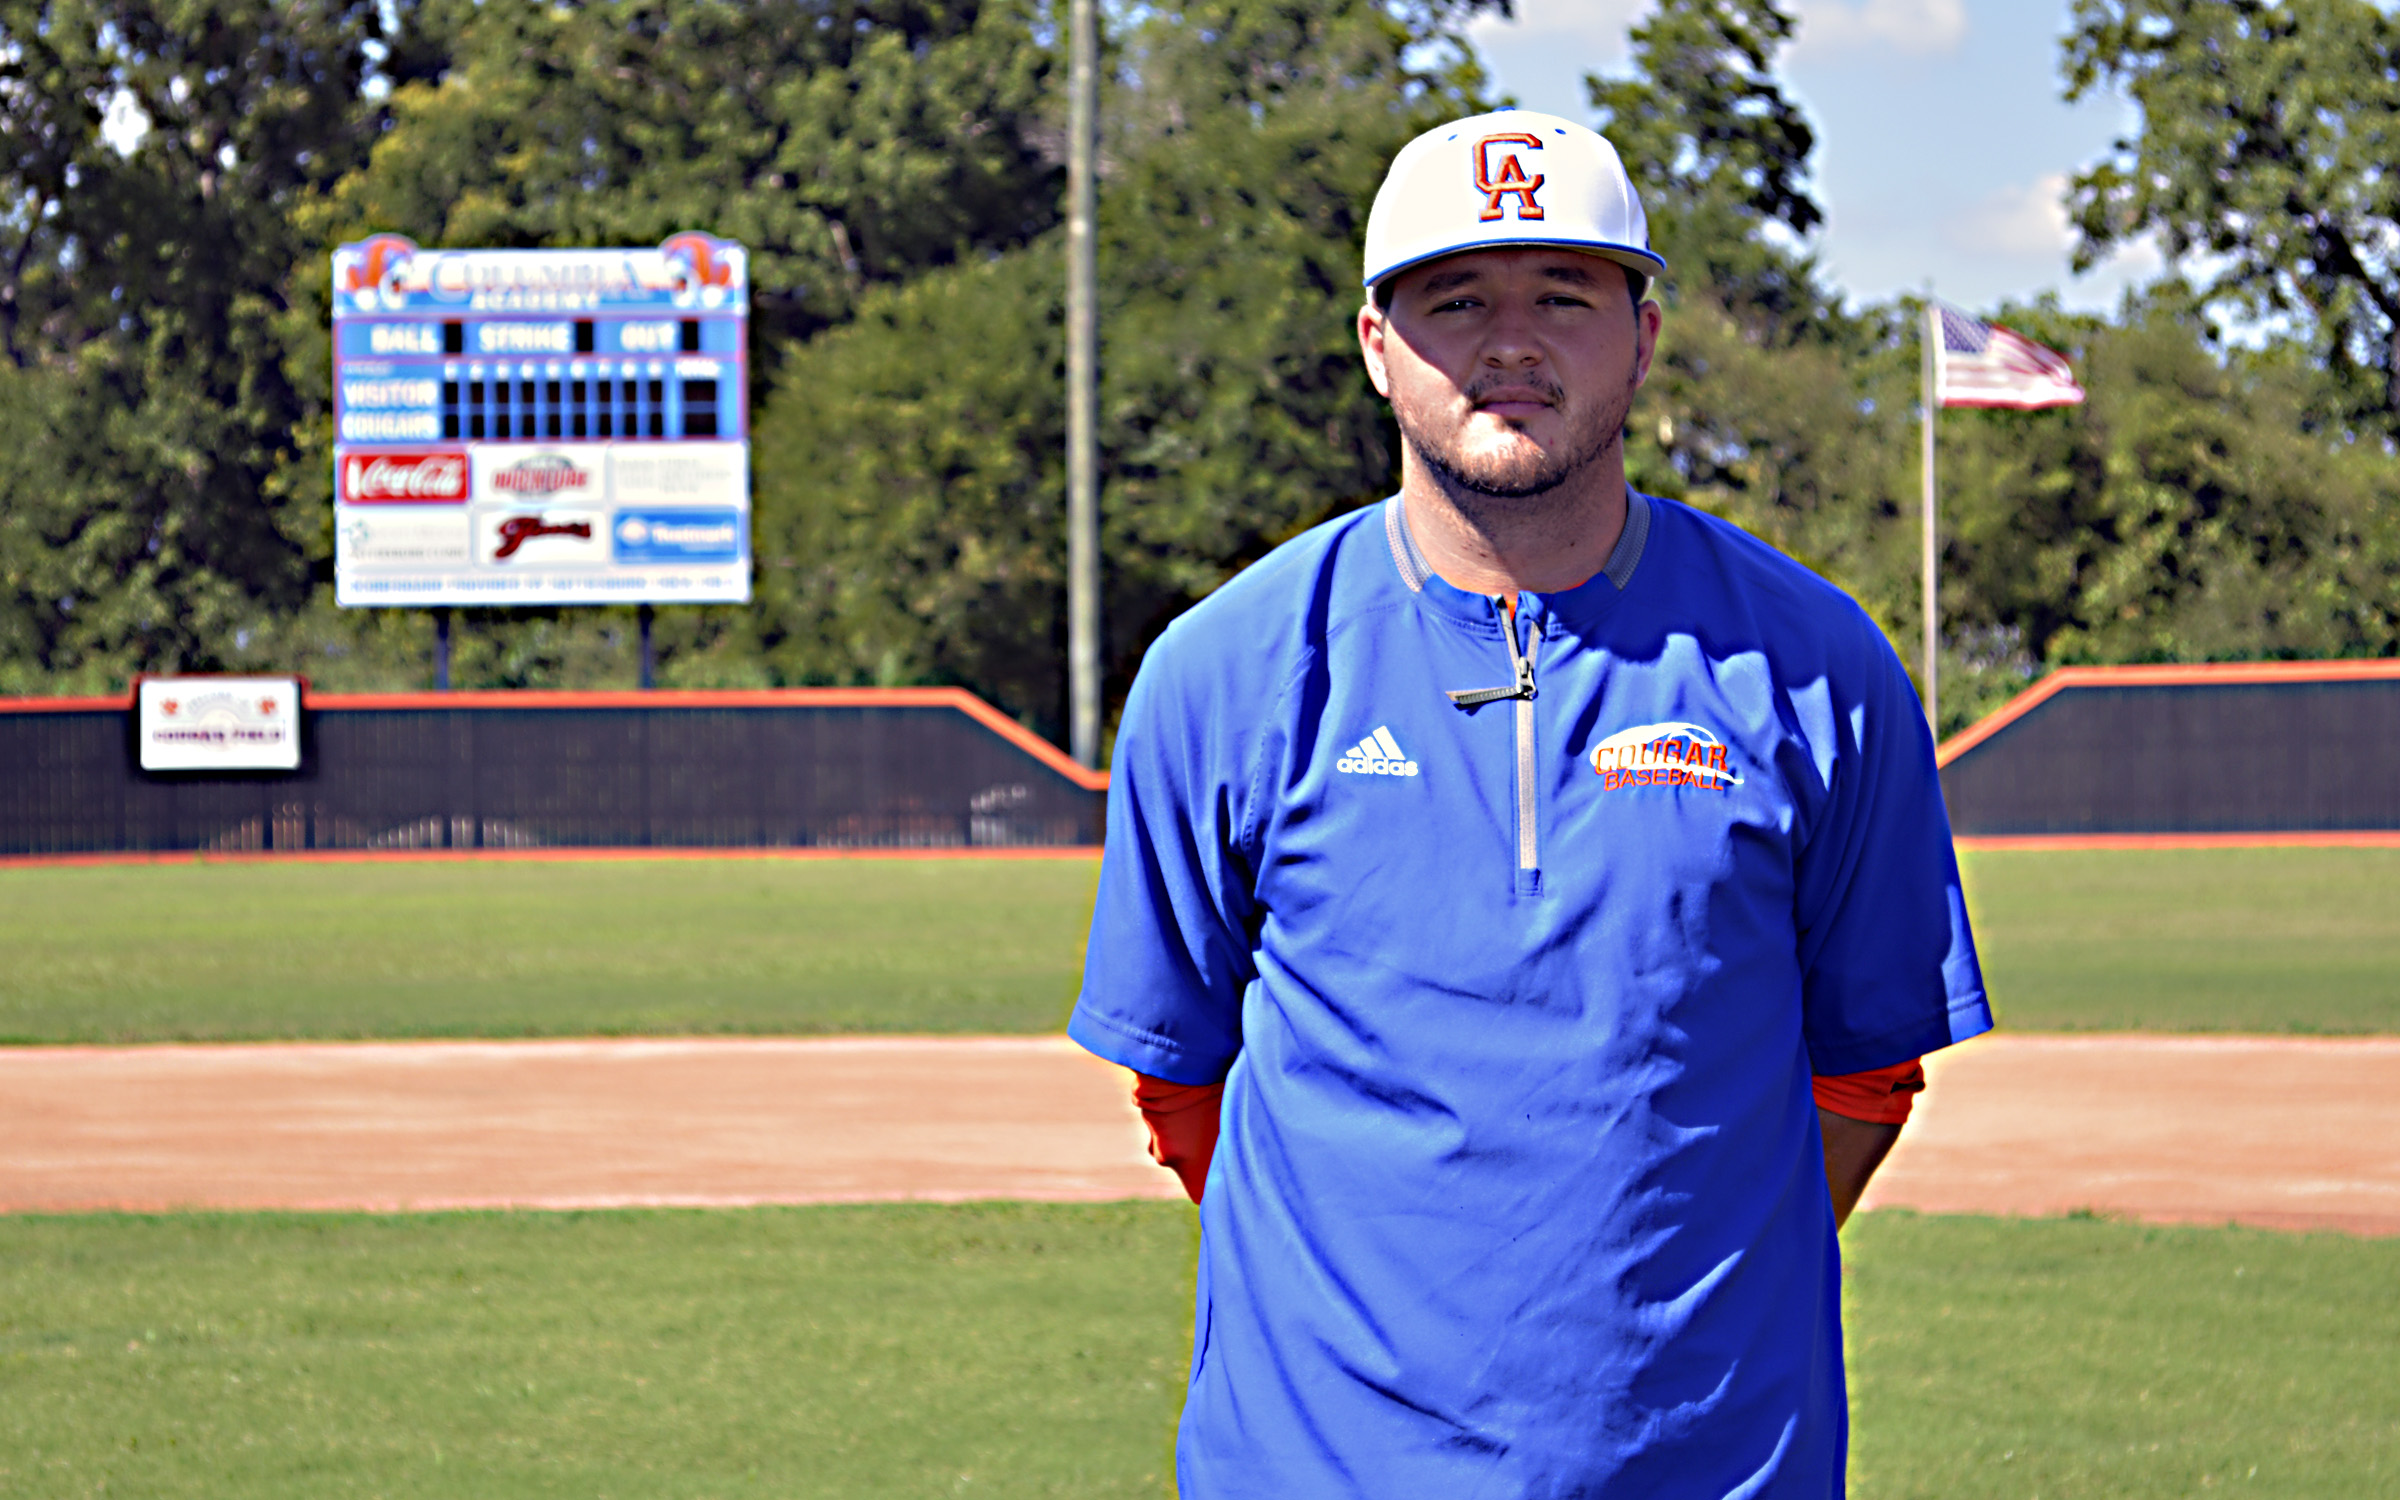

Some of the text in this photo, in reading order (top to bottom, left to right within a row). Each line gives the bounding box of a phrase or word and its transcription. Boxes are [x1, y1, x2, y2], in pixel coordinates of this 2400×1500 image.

[370, 322, 679, 354] BALL STRIKE OUT
[341, 379, 439, 408] VISITOR
[341, 410, 440, 440] COUGARS
[1336, 756, 1419, 777] adidas
[1594, 739, 1729, 776] COUGAR
[1603, 768, 1724, 791] BASEBALL
